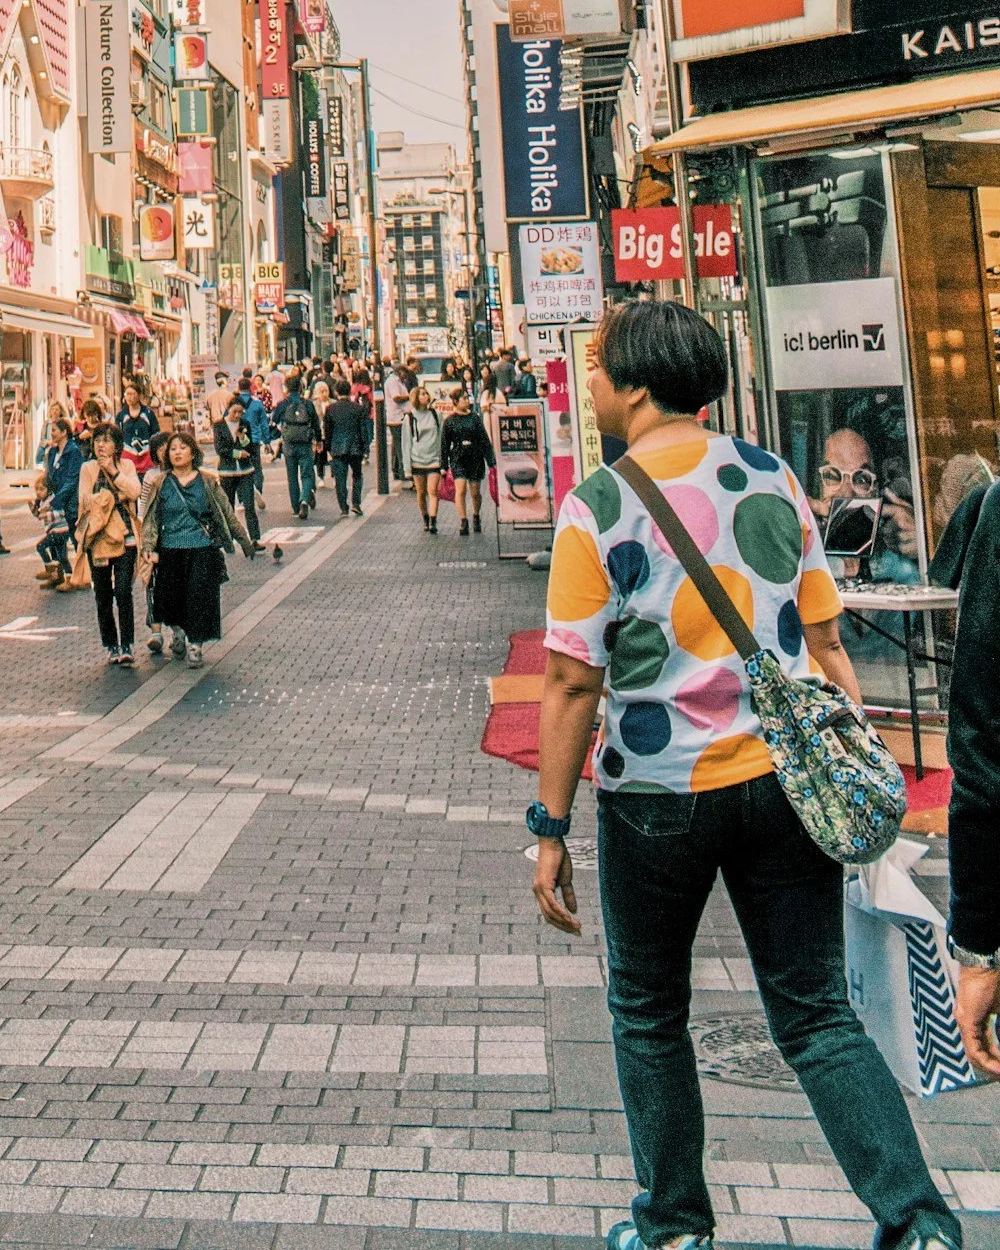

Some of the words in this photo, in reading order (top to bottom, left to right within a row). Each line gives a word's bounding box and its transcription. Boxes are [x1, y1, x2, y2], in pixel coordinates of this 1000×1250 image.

[100, 3, 114, 61] Nature
[265, 46, 277, 65] 2
[271, 82, 285, 94] 3F
[101, 66, 116, 147] Collection
[527, 124, 559, 212] Holika
[309, 162, 320, 196] COFFEE
[185, 210, 208, 237] 光
[527, 227, 554, 244] DD
[619, 225, 664, 268] Big
[258, 266, 280, 278] BIG
[257, 284, 281, 298] MART
[536, 295, 561, 308] 可以
[567, 294, 592, 307] 打包
[529, 311, 568, 321] CHICKEN
[809, 327, 859, 351] berlin
